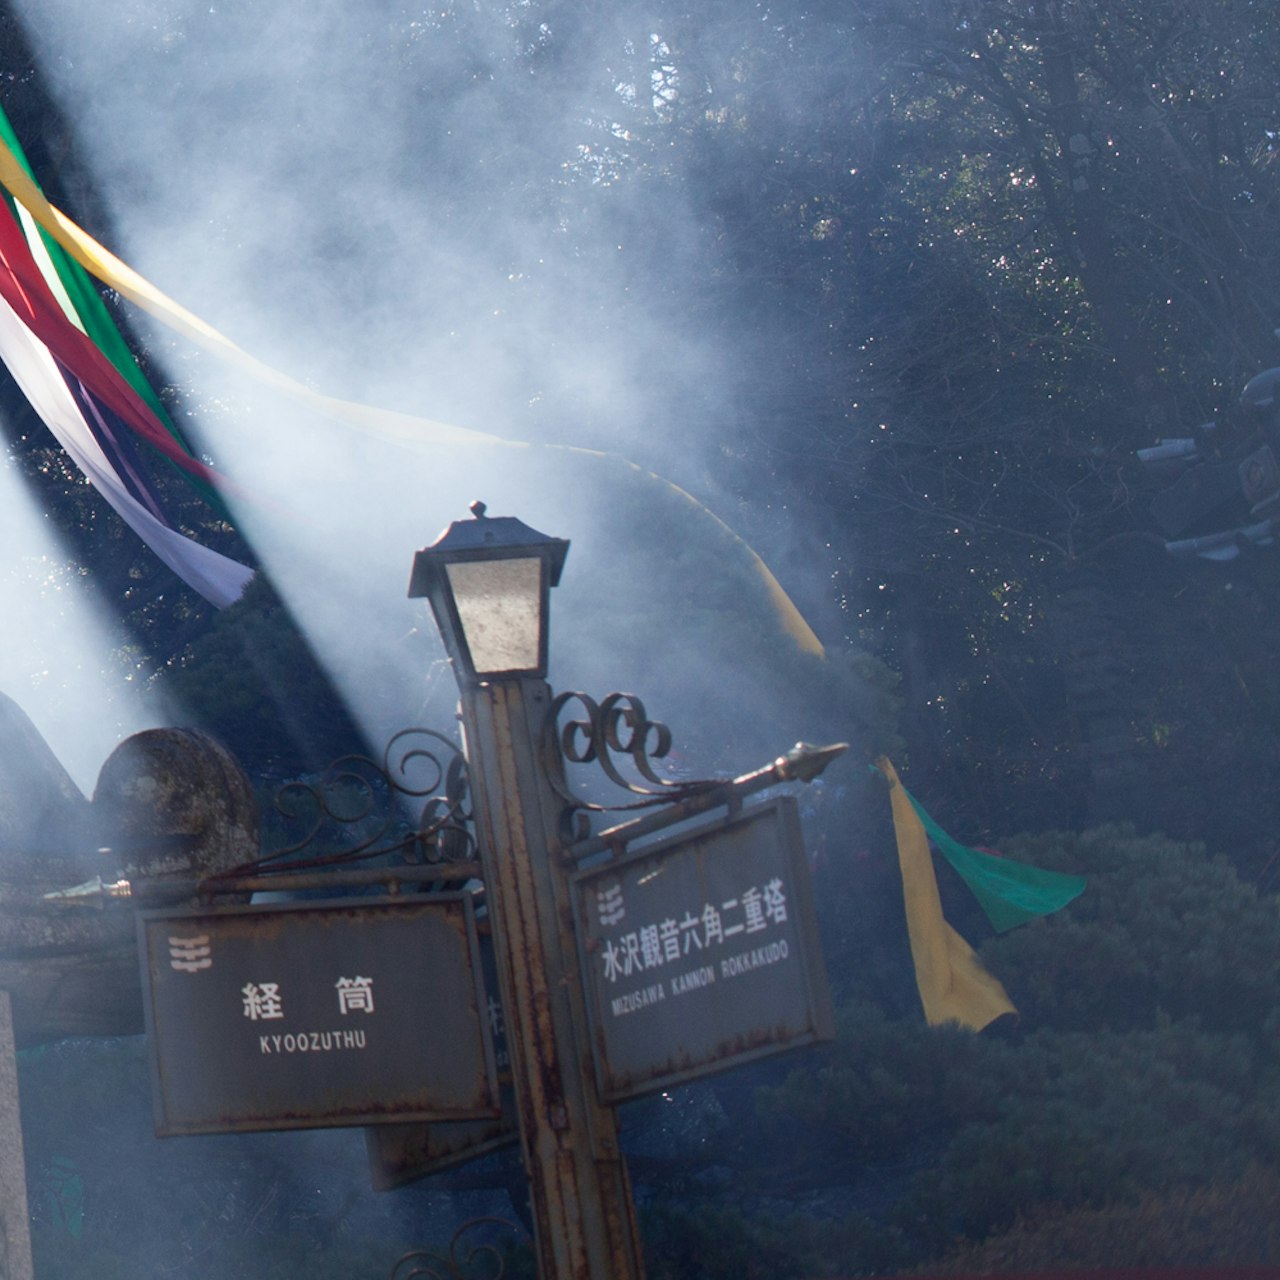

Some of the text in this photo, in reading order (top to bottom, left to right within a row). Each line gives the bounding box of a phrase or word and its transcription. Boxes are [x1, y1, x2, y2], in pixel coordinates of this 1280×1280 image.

[602, 877, 788, 982] 水沢観音六角二重塔
[241, 975, 376, 1021] 経筒
[612, 939, 789, 1017] MIZUSAWA KANNON ROKKAKUDO
[259, 1030, 367, 1054] KYOOZUTHU
